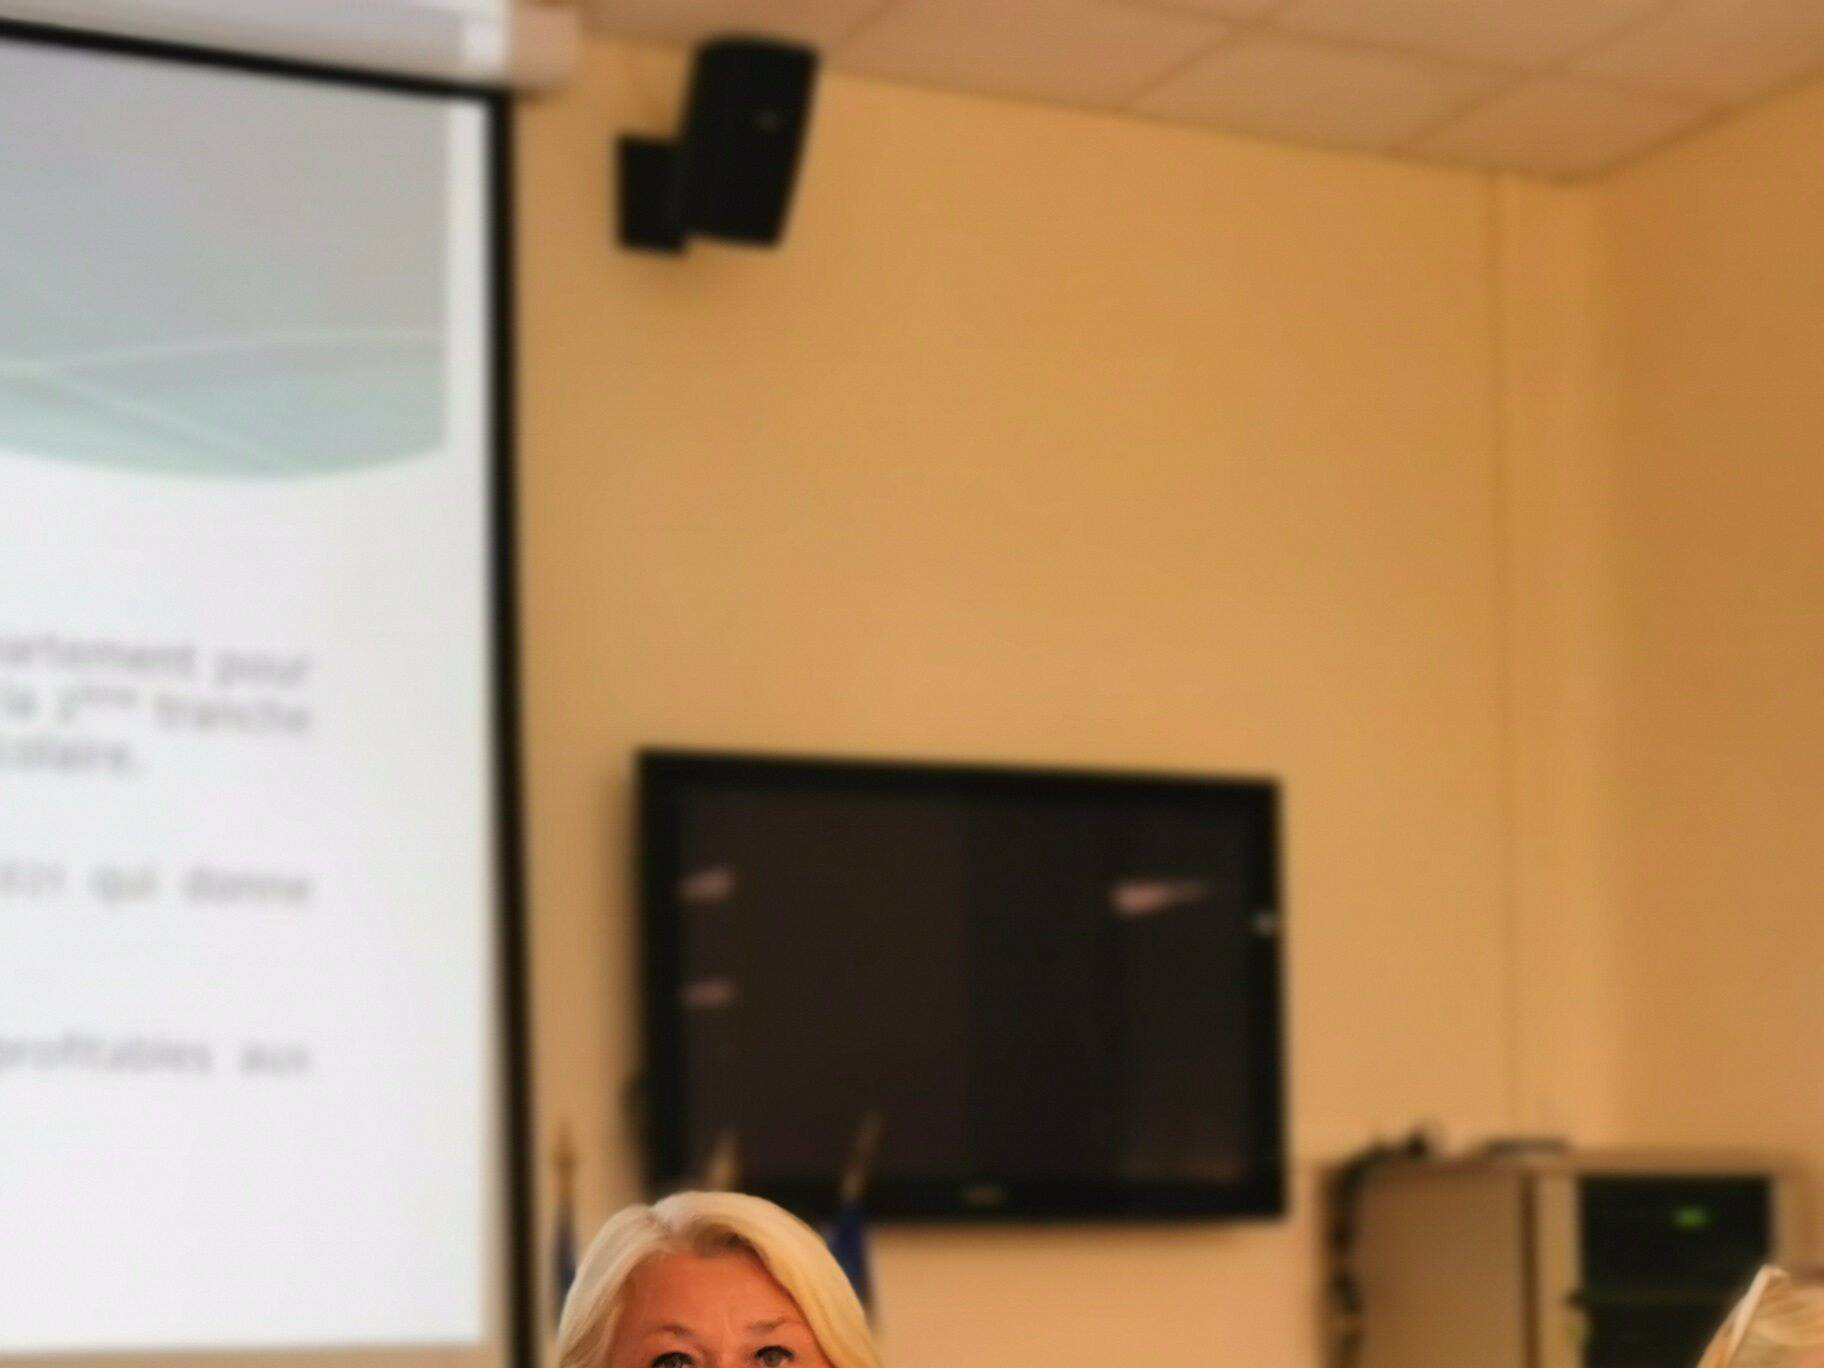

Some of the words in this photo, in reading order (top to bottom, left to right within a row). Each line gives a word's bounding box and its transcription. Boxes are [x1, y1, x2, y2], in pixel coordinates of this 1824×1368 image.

[215, 646, 309, 692] pour
[1, 679, 34, 719] la
[155, 689, 311, 738] tranche
[91, 862, 157, 908] qui
[182, 864, 311, 906] donne
[240, 1042, 311, 1078] aux
